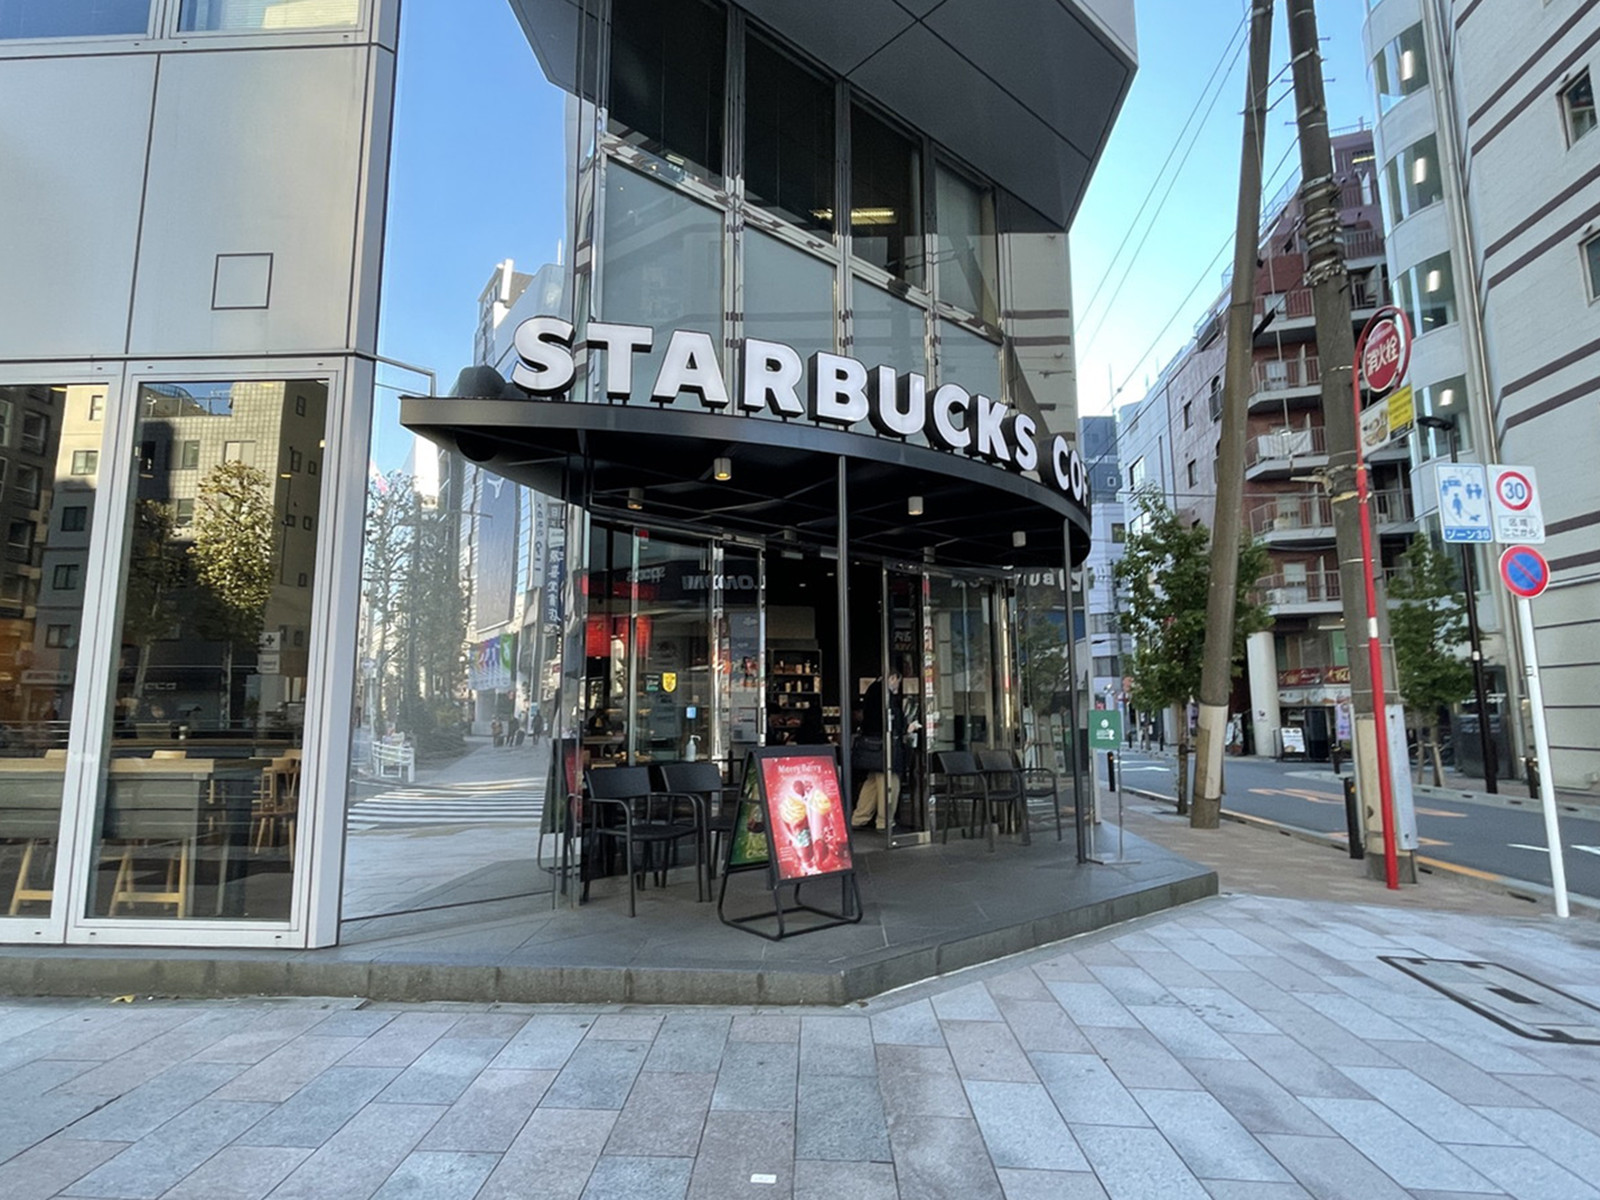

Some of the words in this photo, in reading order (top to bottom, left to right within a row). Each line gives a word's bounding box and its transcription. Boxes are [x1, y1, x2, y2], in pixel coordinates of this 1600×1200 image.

[1366, 334, 1399, 377] 消火栓
[511, 316, 1038, 471] STARBUCKS
[1504, 482, 1525, 500] 30
